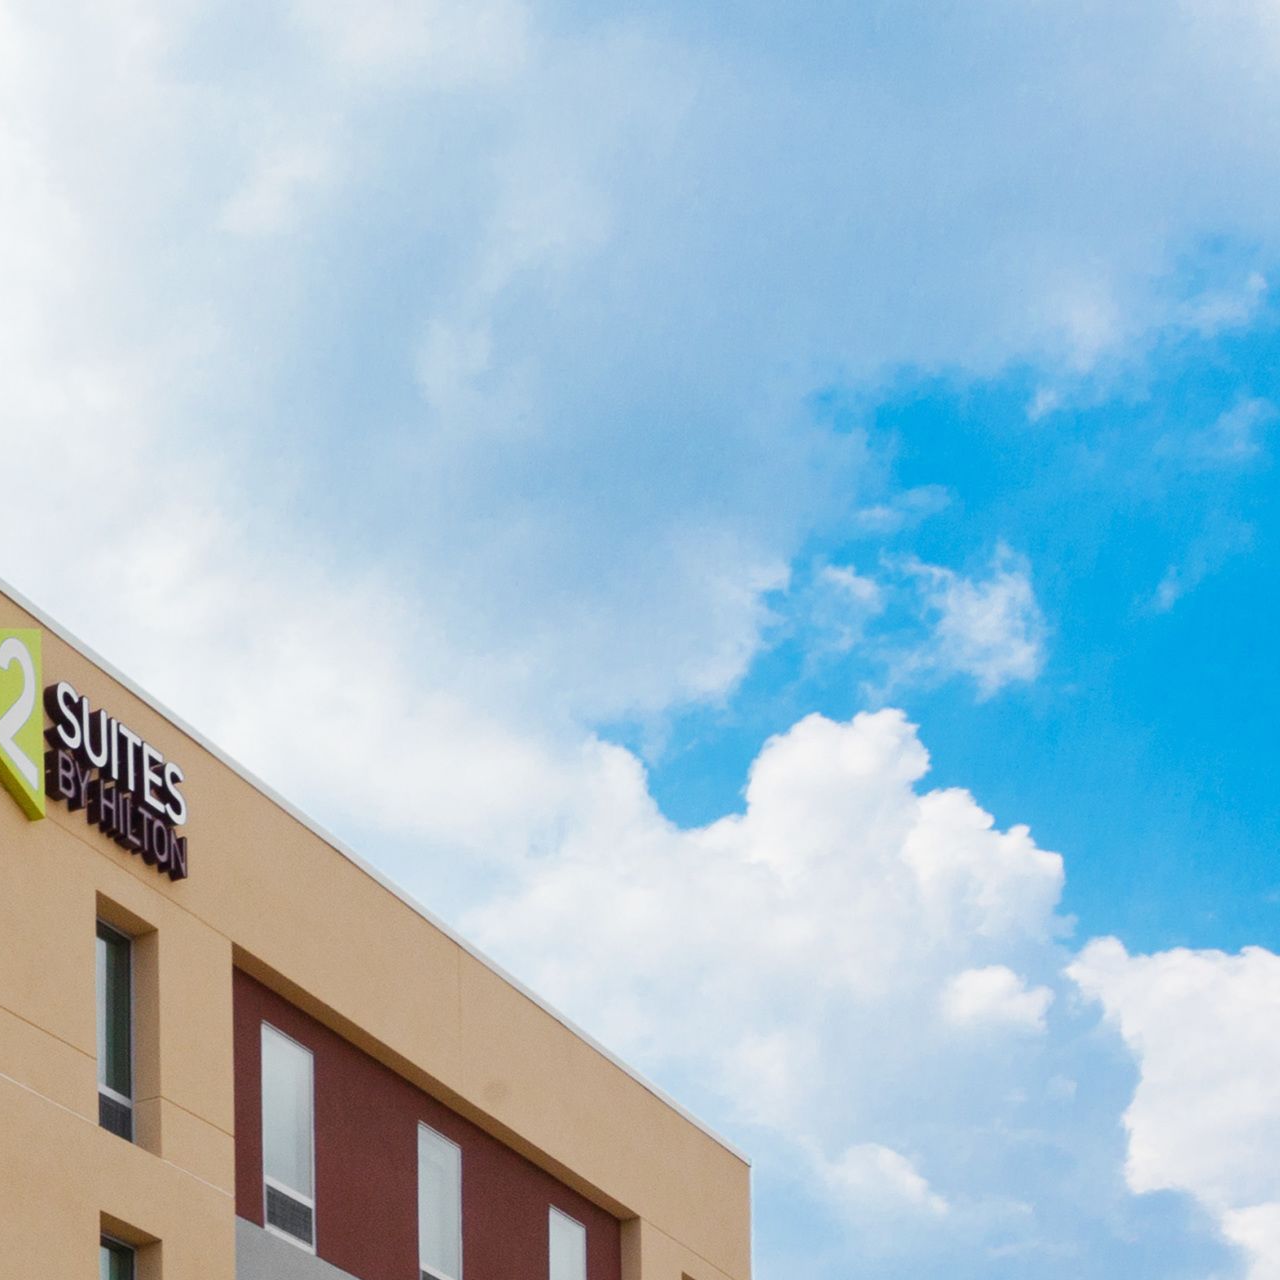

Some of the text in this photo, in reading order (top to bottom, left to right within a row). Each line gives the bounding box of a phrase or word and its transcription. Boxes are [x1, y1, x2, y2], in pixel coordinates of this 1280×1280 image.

[52, 681, 186, 825] SUITES
[57, 750, 188, 878] BY HILTON
